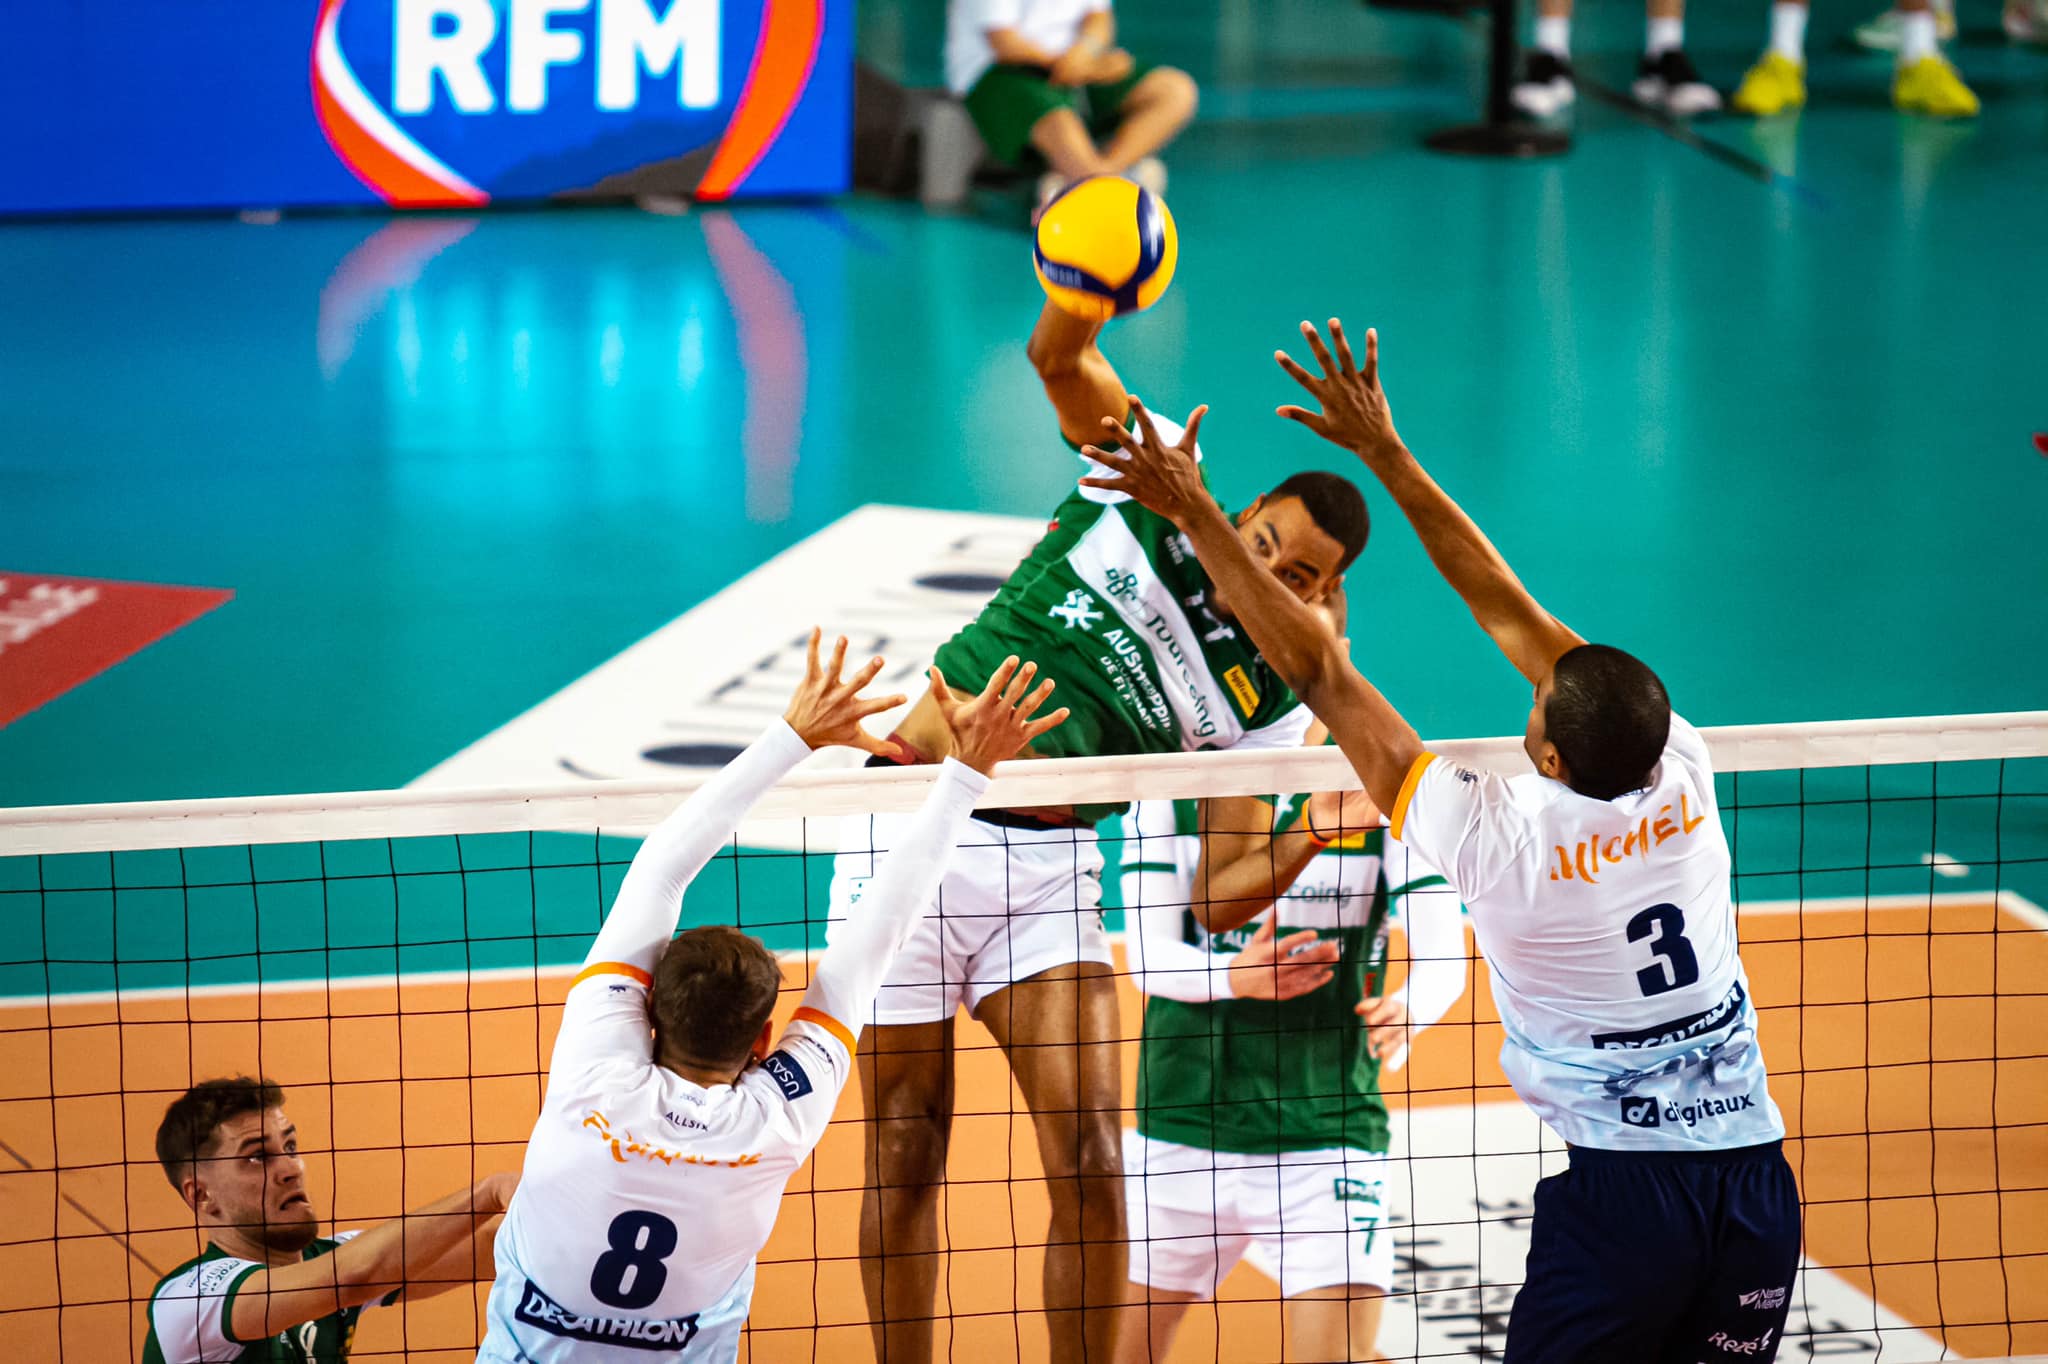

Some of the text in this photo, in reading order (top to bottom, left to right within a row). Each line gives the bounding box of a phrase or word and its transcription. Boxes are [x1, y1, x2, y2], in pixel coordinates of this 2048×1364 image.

[391, 0, 722, 113] RFM
[1550, 794, 1705, 884] MICHEL
[1626, 902, 1699, 998] 3
[666, 1111, 709, 1132] ALLSIX
[1664, 1092, 1755, 1127] digitaux
[590, 1209, 678, 1310] 8
[1353, 1216, 1379, 1255] 7
[523, 1291, 690, 1343] DECATHLON
